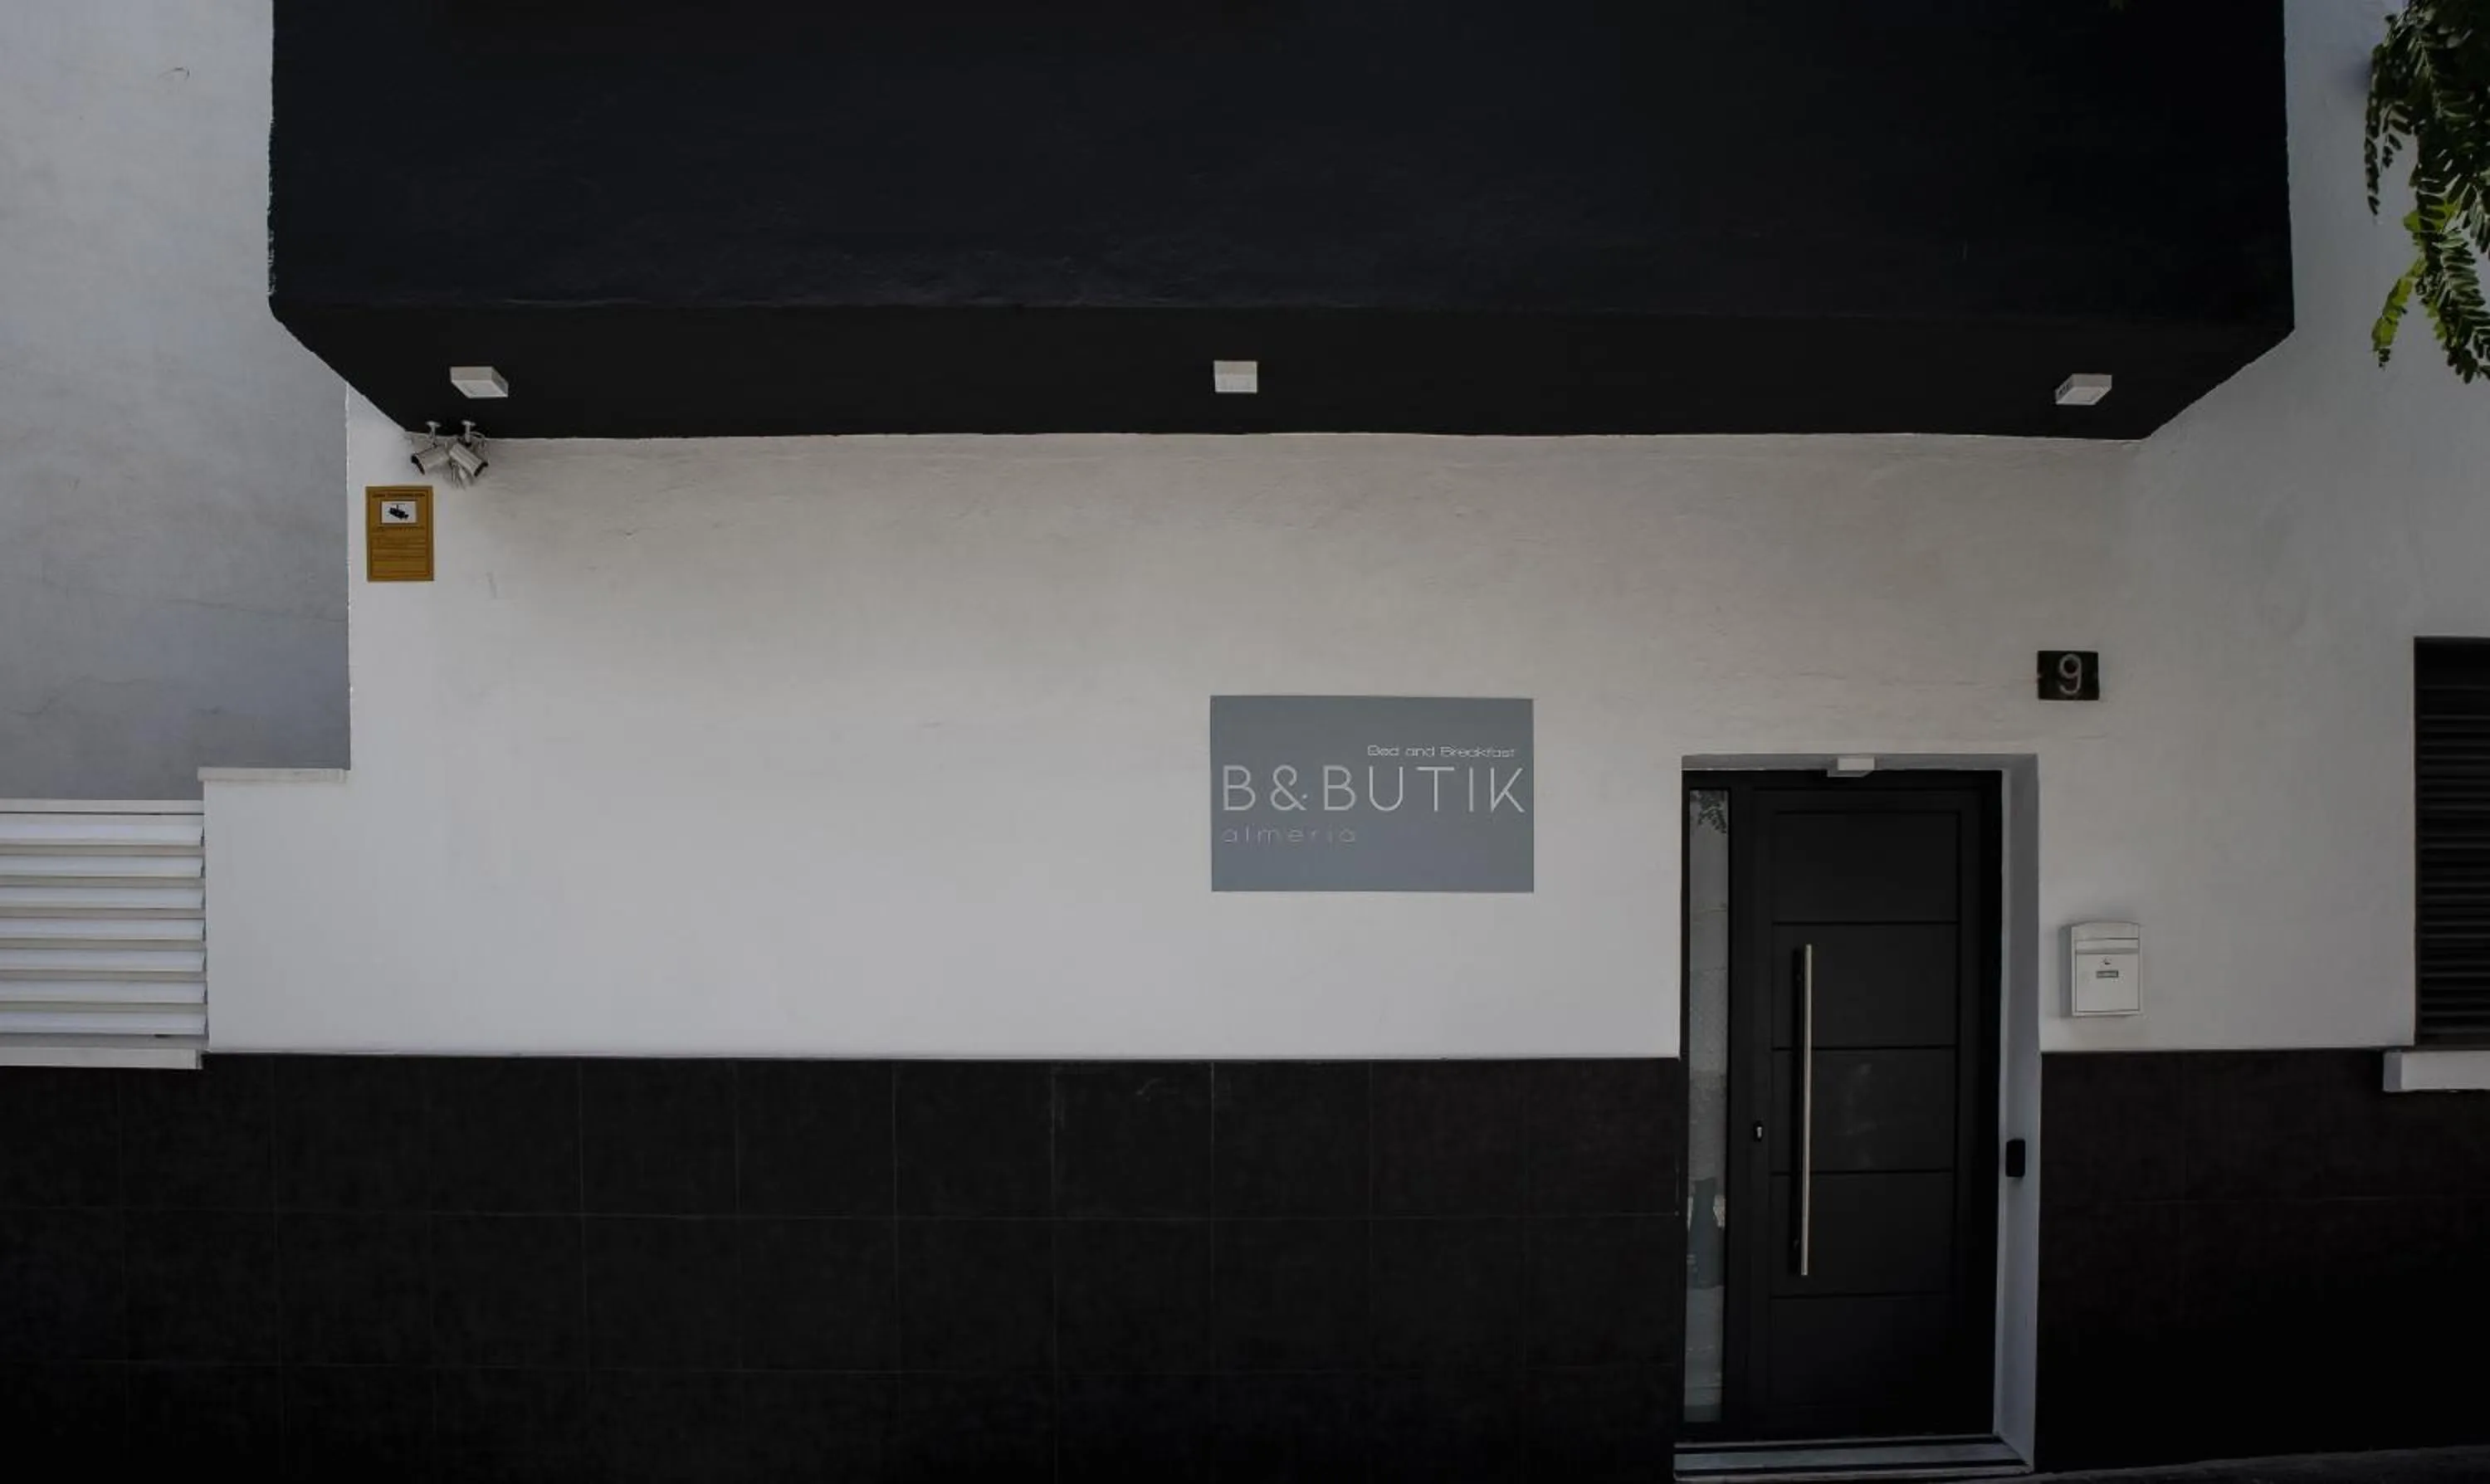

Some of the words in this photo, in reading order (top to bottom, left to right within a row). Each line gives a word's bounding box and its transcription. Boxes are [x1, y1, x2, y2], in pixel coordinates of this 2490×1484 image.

[2058, 653, 2082, 696] 9
[1367, 744, 1400, 757] Bed
[1405, 745, 1435, 757] and
[1440, 746, 1517, 758] Breakfast
